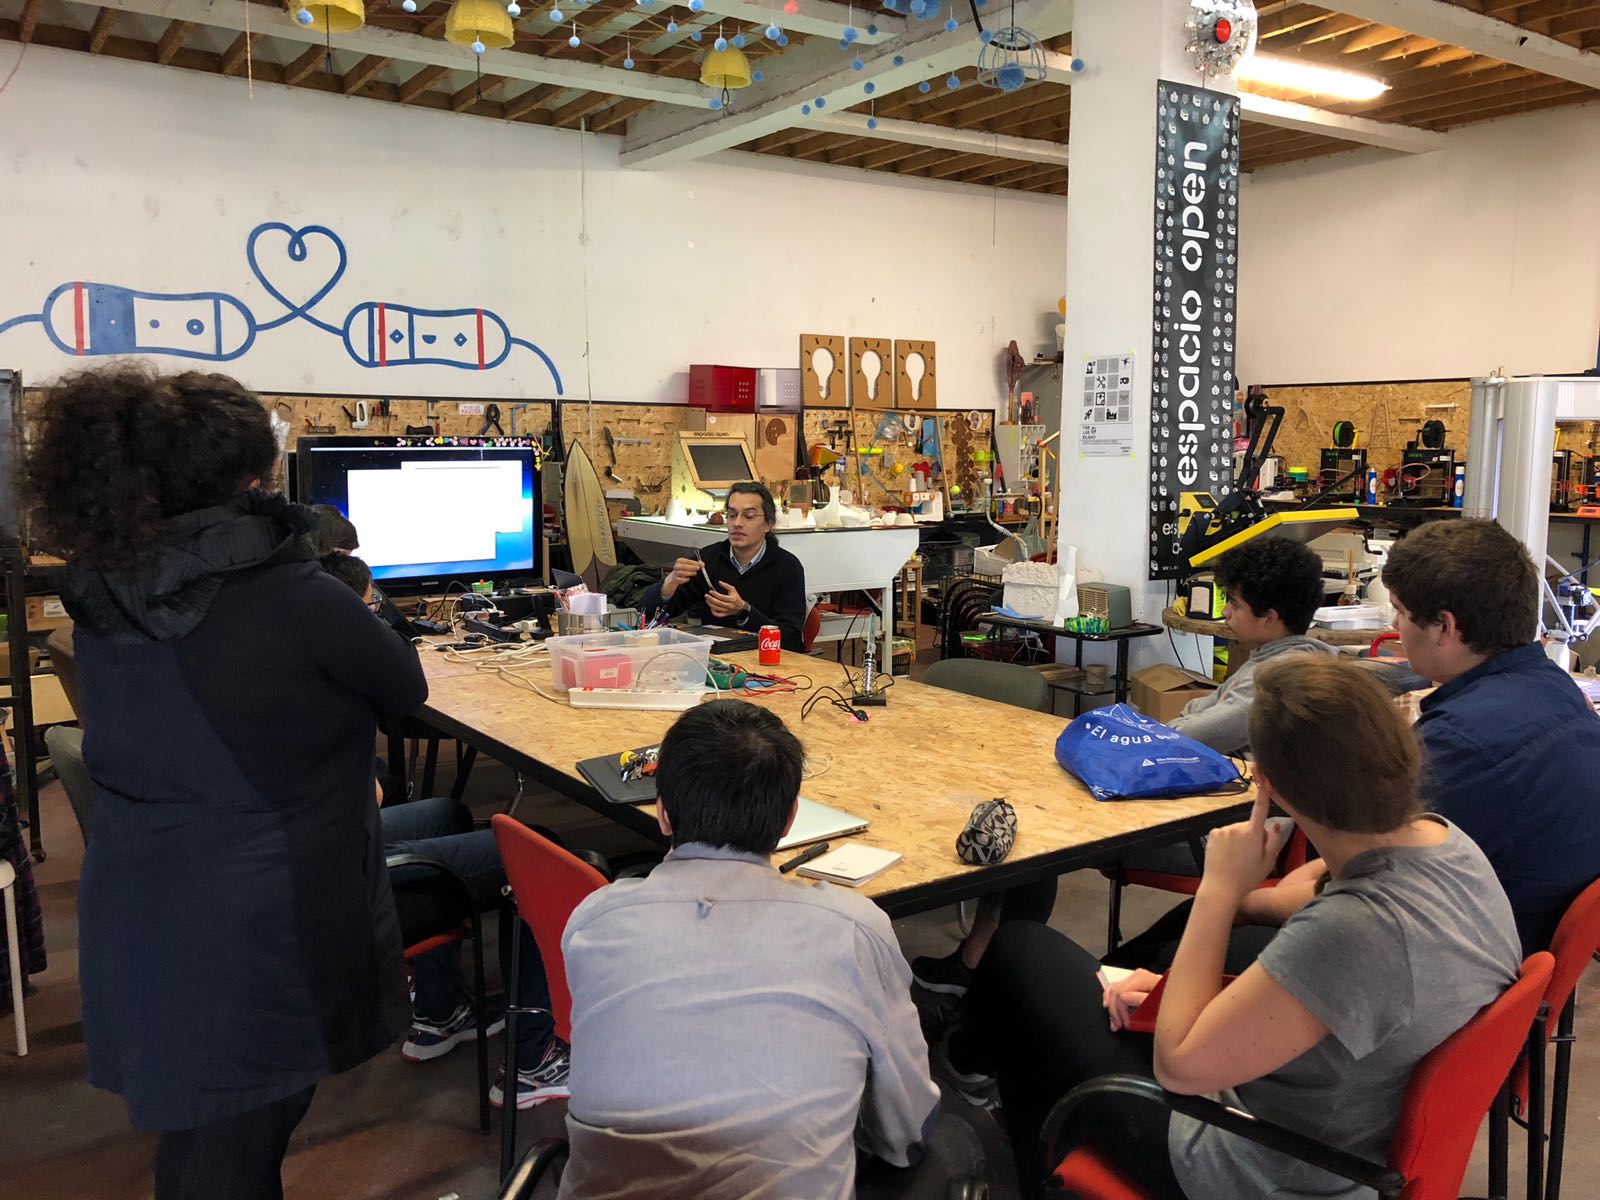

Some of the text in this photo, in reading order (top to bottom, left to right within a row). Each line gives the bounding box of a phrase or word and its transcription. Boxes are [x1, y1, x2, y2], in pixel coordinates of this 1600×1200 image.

[1174, 141, 1210, 485] espacio open
[1090, 725, 1107, 738] El
[1110, 734, 1152, 746] agua
